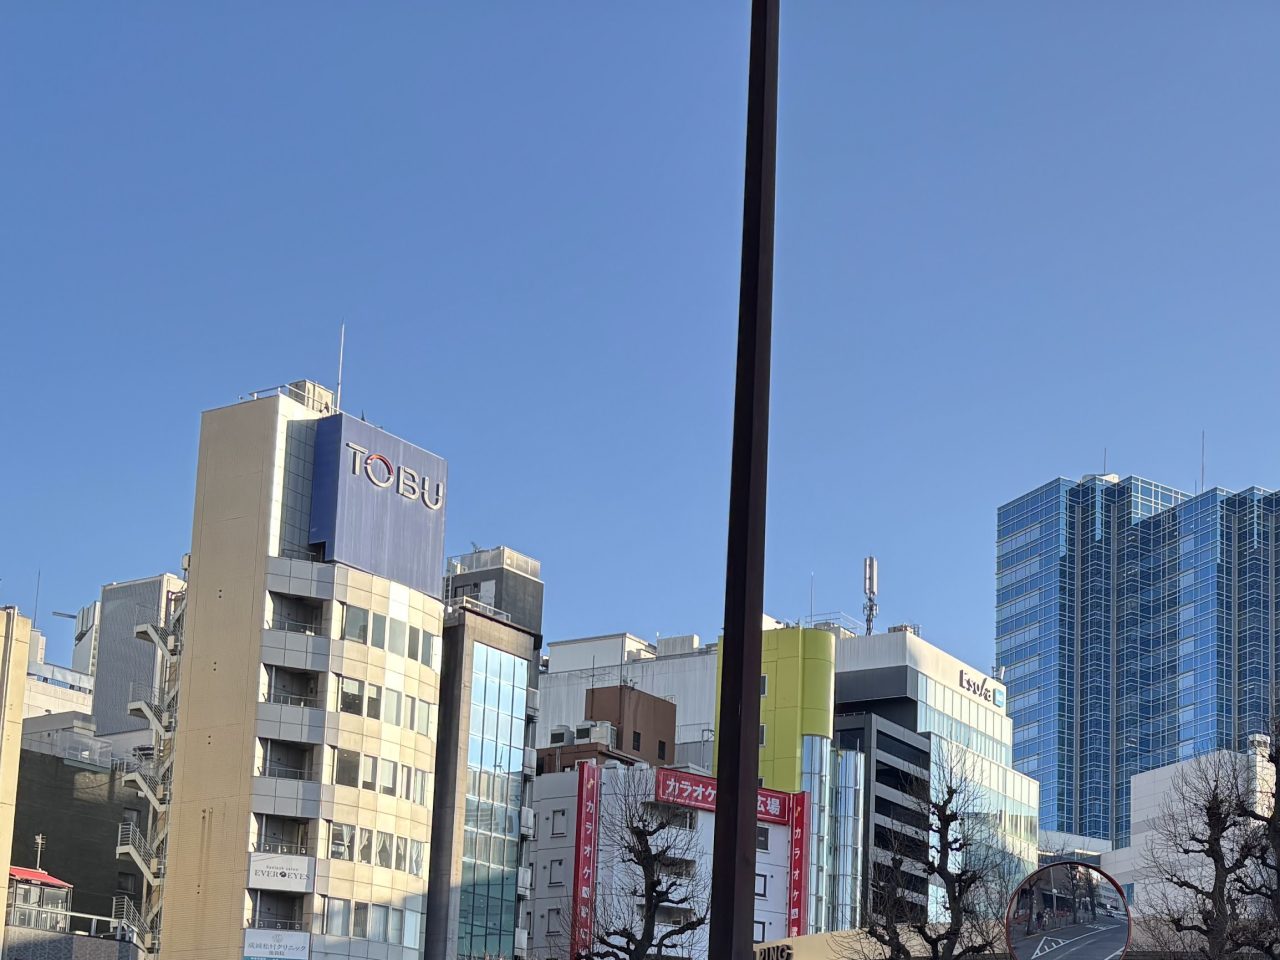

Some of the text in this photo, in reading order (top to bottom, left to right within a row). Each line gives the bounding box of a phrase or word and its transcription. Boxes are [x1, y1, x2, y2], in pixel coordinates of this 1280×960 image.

[346, 442, 444, 510] TOBU
[666, 778, 717, 802] カラオケ
[583, 800, 595, 880] カラオケ
[792, 826, 802, 901] カラオケ
[254, 869, 311, 881] EVER EYES
